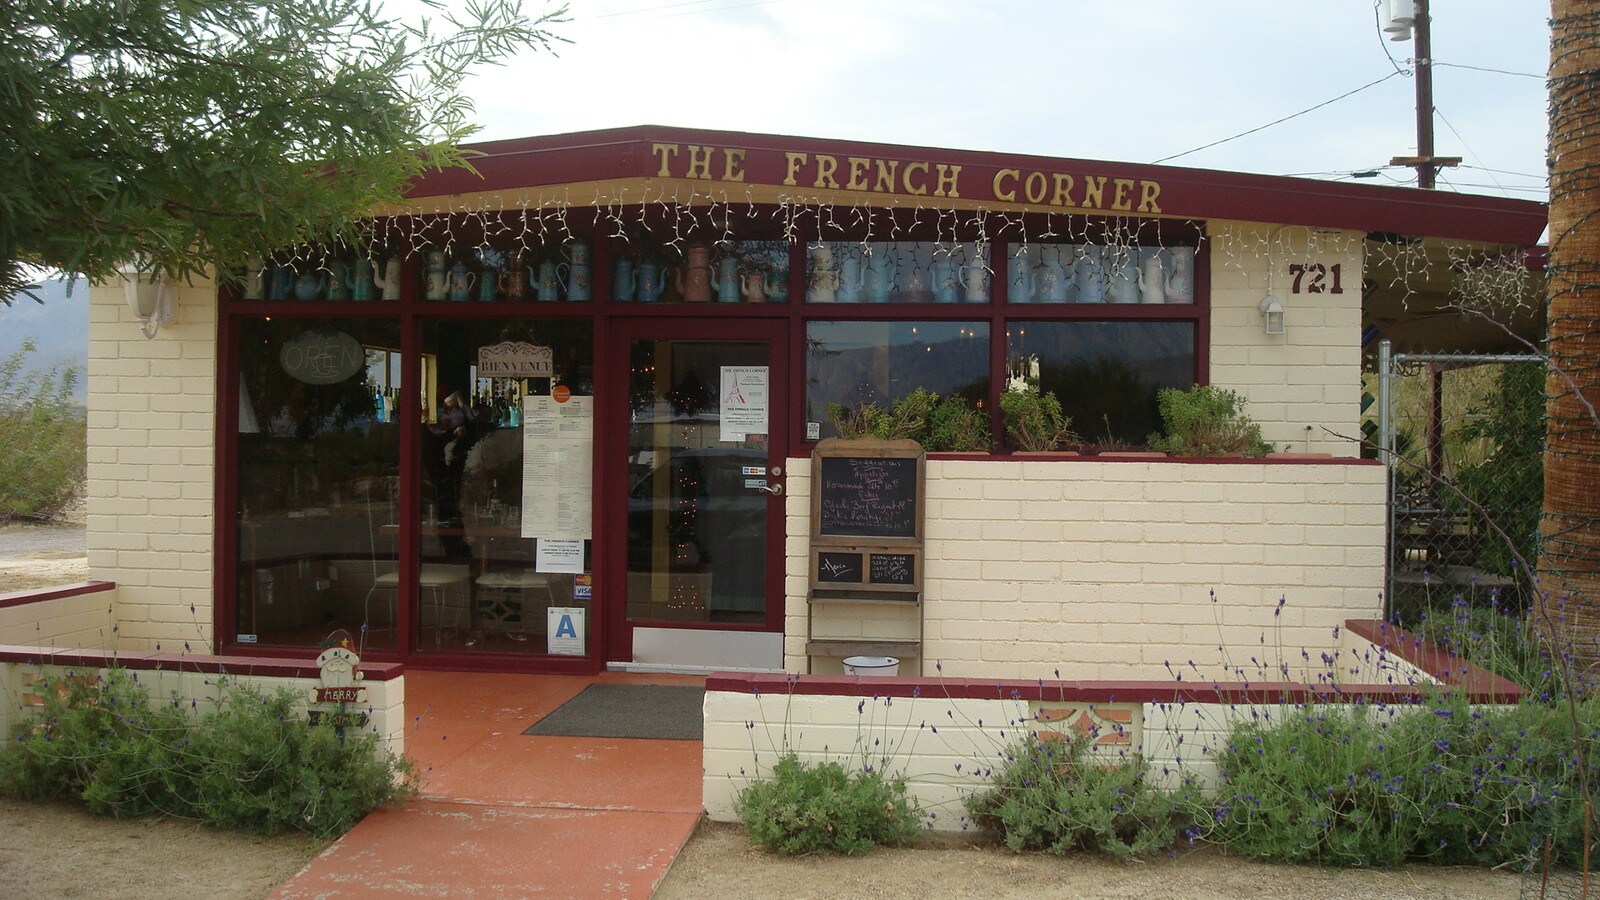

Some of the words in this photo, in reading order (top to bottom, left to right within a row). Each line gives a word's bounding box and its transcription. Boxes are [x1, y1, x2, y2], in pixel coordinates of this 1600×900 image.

[652, 143, 746, 182] THE
[783, 151, 962, 198] FRENCH
[992, 168, 1162, 214] CORNER
[1289, 263, 1344, 294] 721
[286, 344, 358, 369] OPEN
[481, 361, 552, 372] BIENVENUE
[555, 614, 577, 638] A
[323, 688, 358, 700] MERRY
